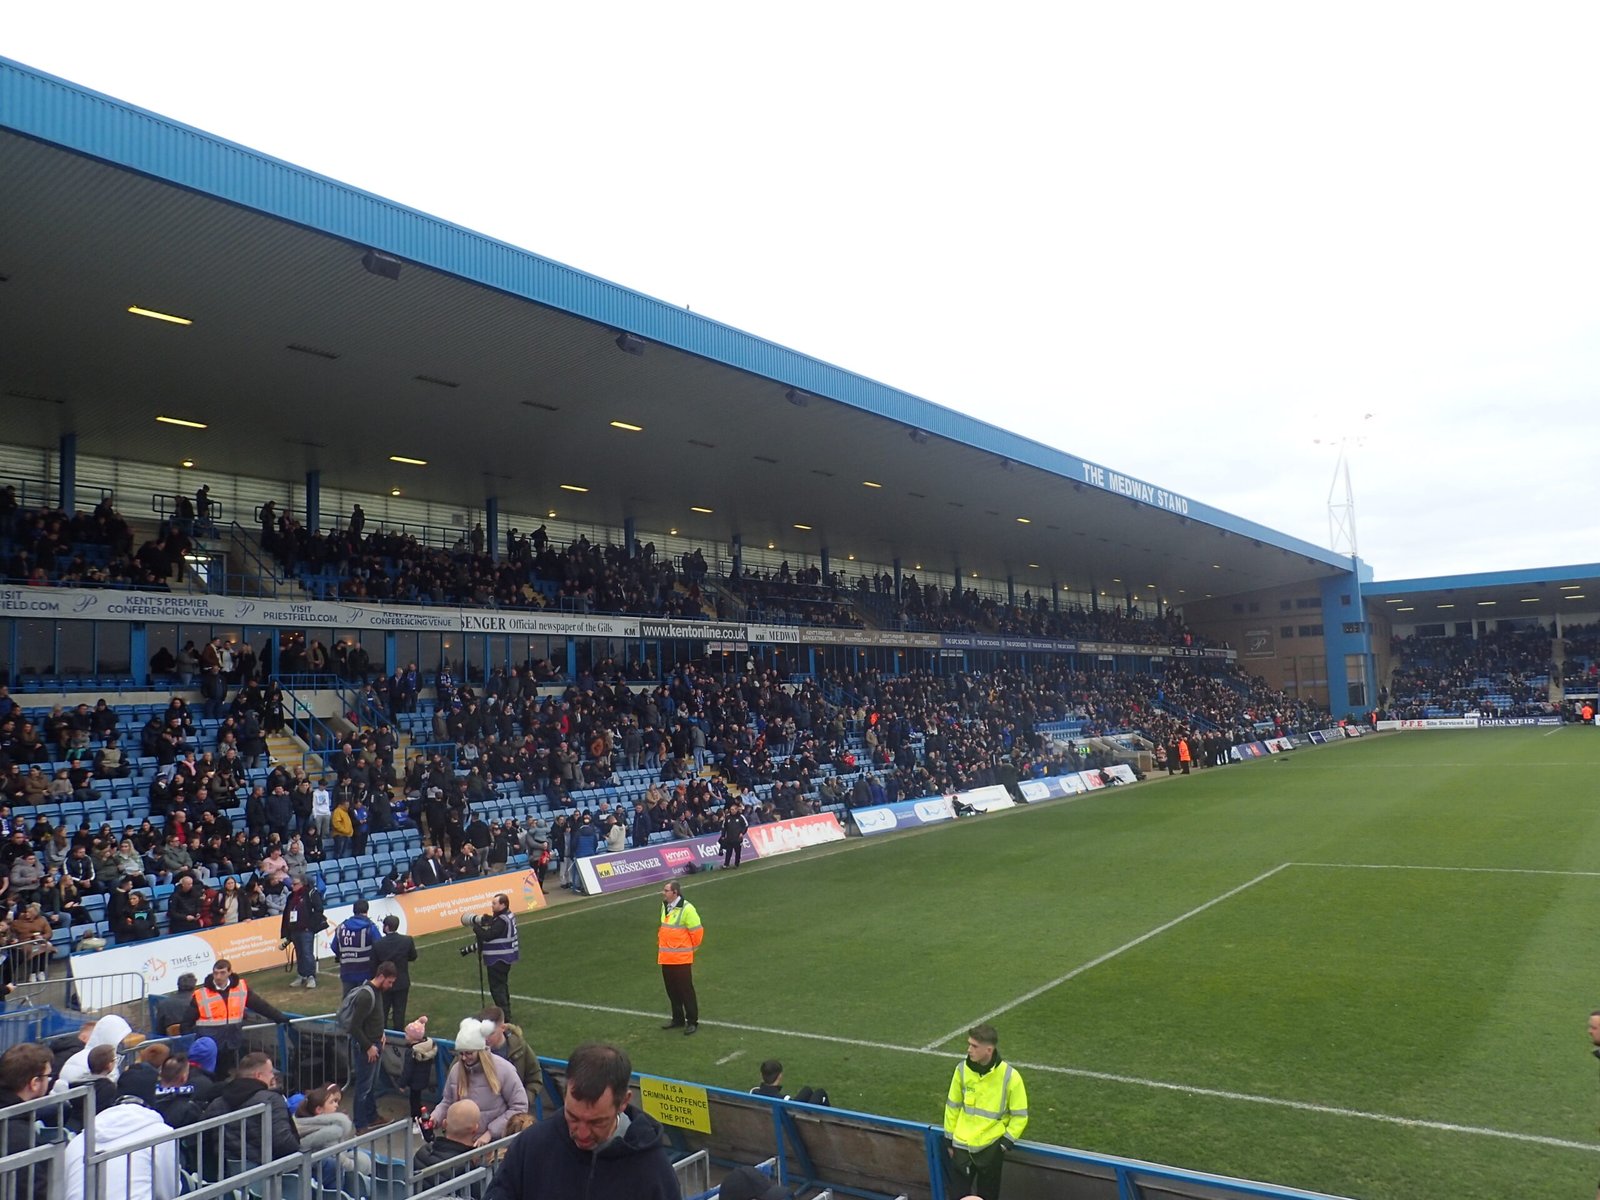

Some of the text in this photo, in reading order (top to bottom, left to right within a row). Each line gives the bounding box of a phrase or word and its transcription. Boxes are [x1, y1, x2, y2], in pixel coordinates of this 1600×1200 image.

[1082, 463, 1188, 514] THE MEDWAY STAND
[0, 601, 60, 611] IELD.COM
[126, 596, 208, 608] KENT'S PREMIER
[107, 605, 225, 617] CONFERENCING VENUE
[290, 605, 312, 613] VISIT
[263, 612, 337, 623] PRIESTFIELD.COM
[370, 617, 428, 626] CONFERENCING
[428, 619, 452, 627] VENUE
[509, 618, 537, 630] Official
[539, 620, 577, 633] newspaper
[577, 622, 584, 631] of
[585, 622, 597, 632] the
[597, 623, 613, 632] Gills
[624, 628, 636, 636] KM
[643, 624, 746, 640] www.kentonline.co.uk
[756, 631, 798, 641] KM MEDWAY
[1480, 718, 1535, 727] JOHN WEIR
[600, 869, 611, 877] KM
[613, 858, 661, 875] MESSENGER
[414, 900, 451, 913] Supporting
[451, 893, 485, 906] Vulnerable
[440, 909, 447, 917] of
[447, 908, 458, 916] our
[230, 935, 262, 945] Supporting
[344, 937, 353, 946] 01
[241, 946, 276, 957] Community
[171, 955, 192, 965] TIME
[662, 1083, 668, 1091] IT
[642, 1090, 707, 1109] CRIMINAL OFFENCE
[660, 1102, 692, 1115] TO ENTER
[660, 1112, 695, 1126] THE PITCH
